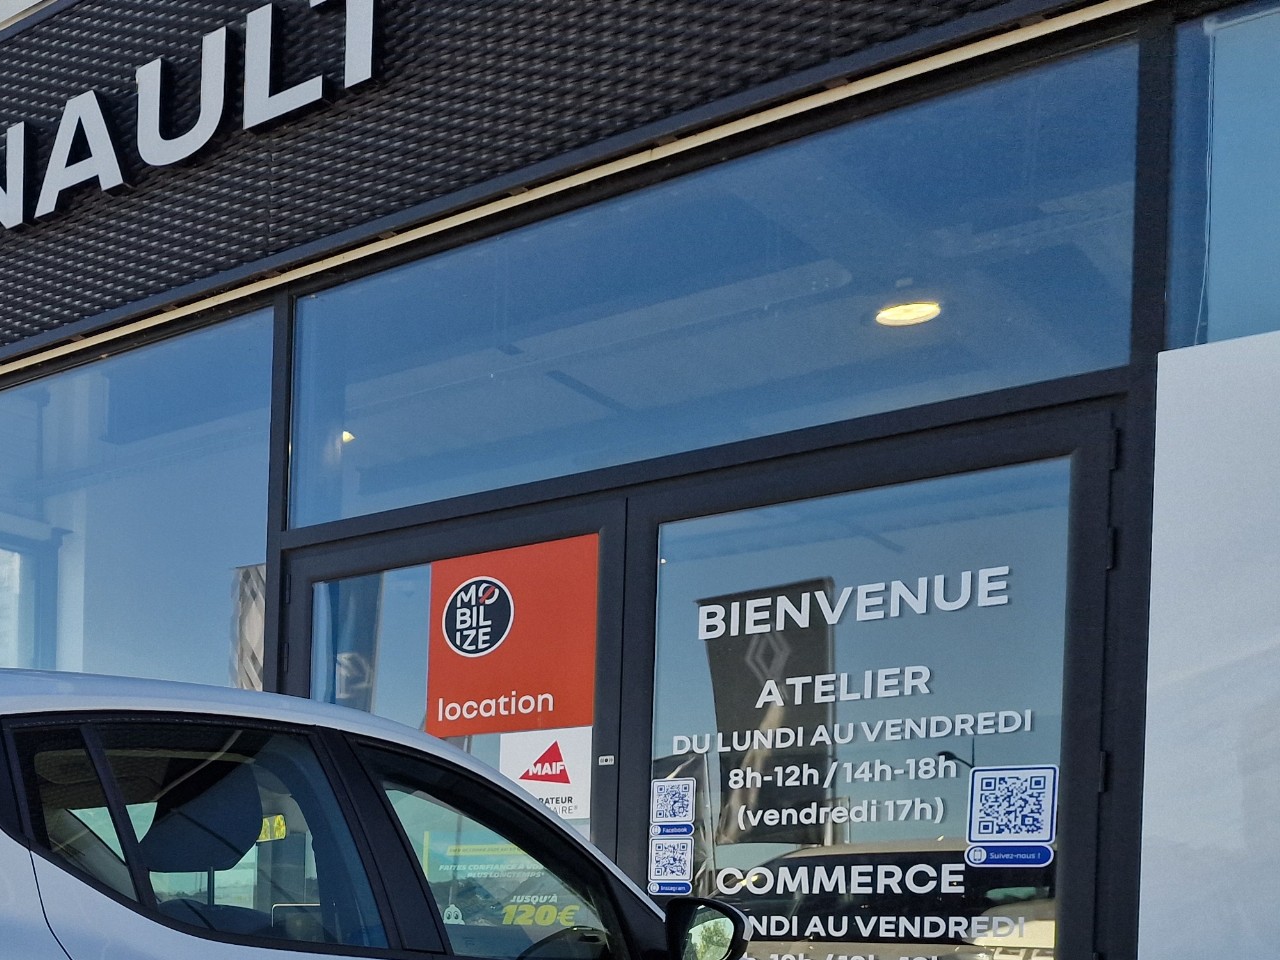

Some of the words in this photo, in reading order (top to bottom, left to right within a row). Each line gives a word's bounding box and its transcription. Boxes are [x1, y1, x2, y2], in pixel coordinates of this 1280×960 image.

[698, 566, 1010, 640] BIENVENUE
[755, 665, 931, 709] ATELIER
[438, 690, 554, 721] location
[672, 733, 711, 755] DU
[717, 726, 804, 753] LUNDI
[810, 722, 854, 748] AU
[861, 709, 1032, 742] VENDREDI
[528, 762, 565, 776] MAIF
[728, 762, 819, 789] 8h-12h
[844, 756, 957, 783] 14h-18h
[737, 800, 880, 830] (vendredi
[885, 796, 945, 824] 17h)
[716, 863, 966, 895] COMMERCE
[502, 904, 580, 926] 120€
[804, 916, 848, 937] AU
[854, 915, 1025, 938] VENDREDI
